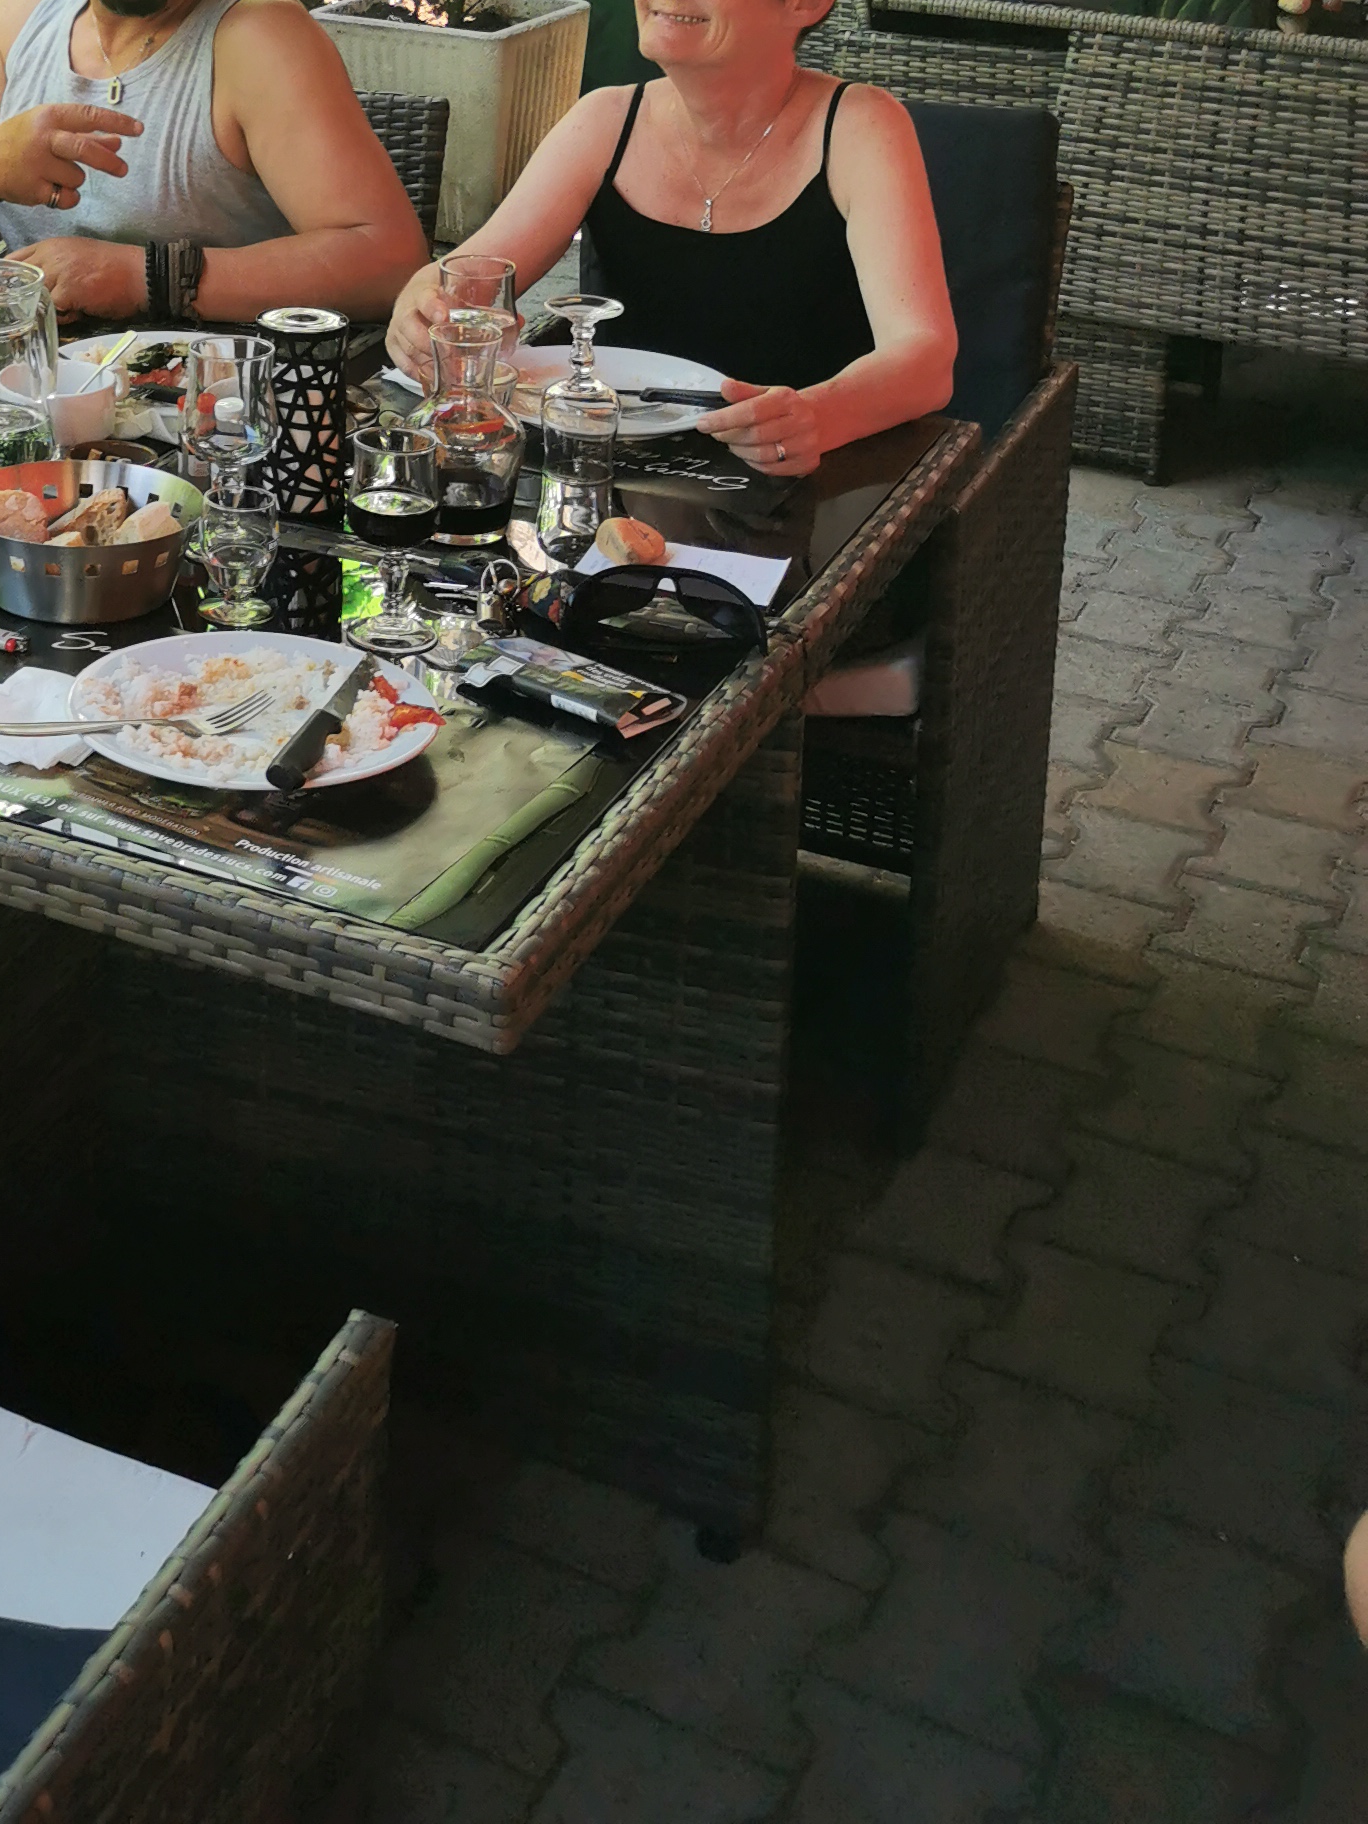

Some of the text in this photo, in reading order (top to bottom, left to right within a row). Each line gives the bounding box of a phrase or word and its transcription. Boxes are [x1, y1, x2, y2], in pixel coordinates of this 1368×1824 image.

[23, 791, 57, 808] (43)
[56, 802, 77, 815] ou
[77, 810, 106, 823] sur
[234, 838, 382, 891] Production artisanale
